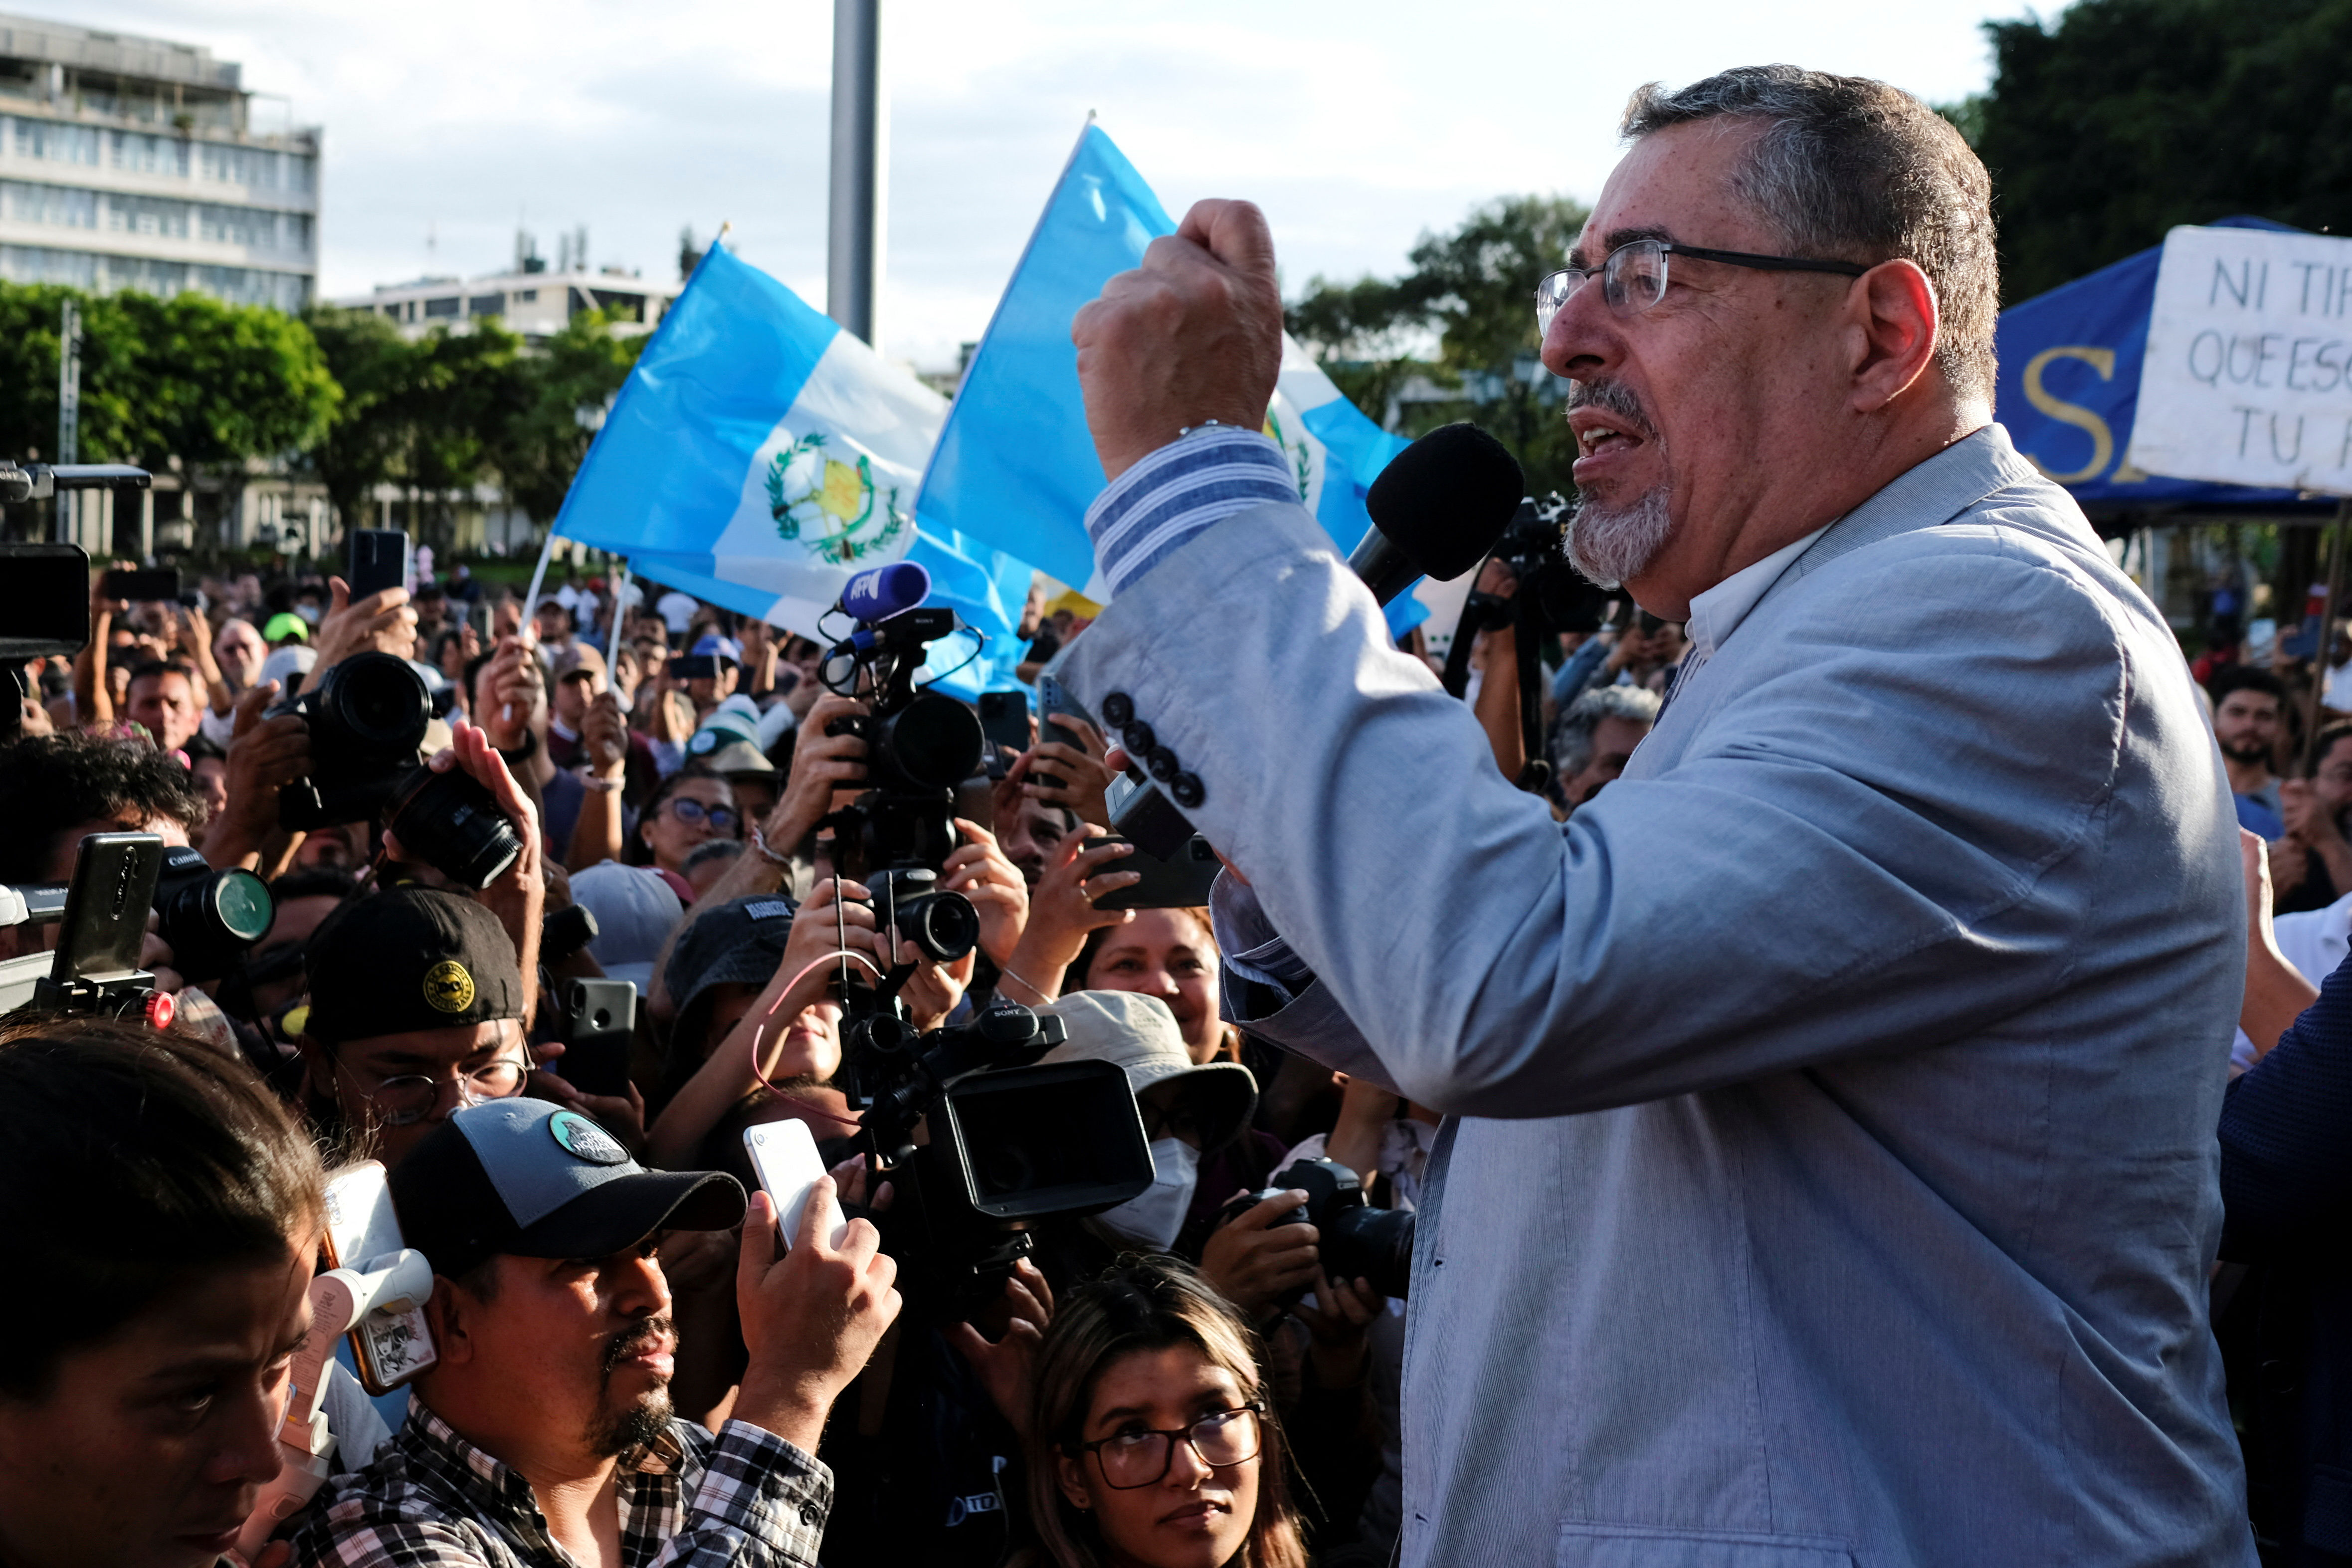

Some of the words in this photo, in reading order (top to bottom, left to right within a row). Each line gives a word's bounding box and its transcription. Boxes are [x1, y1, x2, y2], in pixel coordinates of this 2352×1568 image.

[2209, 256, 2268, 311] NI
[2231, 405, 2304, 466] TU
[850, 574, 873, 601] AFP
[168, 852, 200, 867] Canon
[993, 1008, 1019, 1017] SONY
